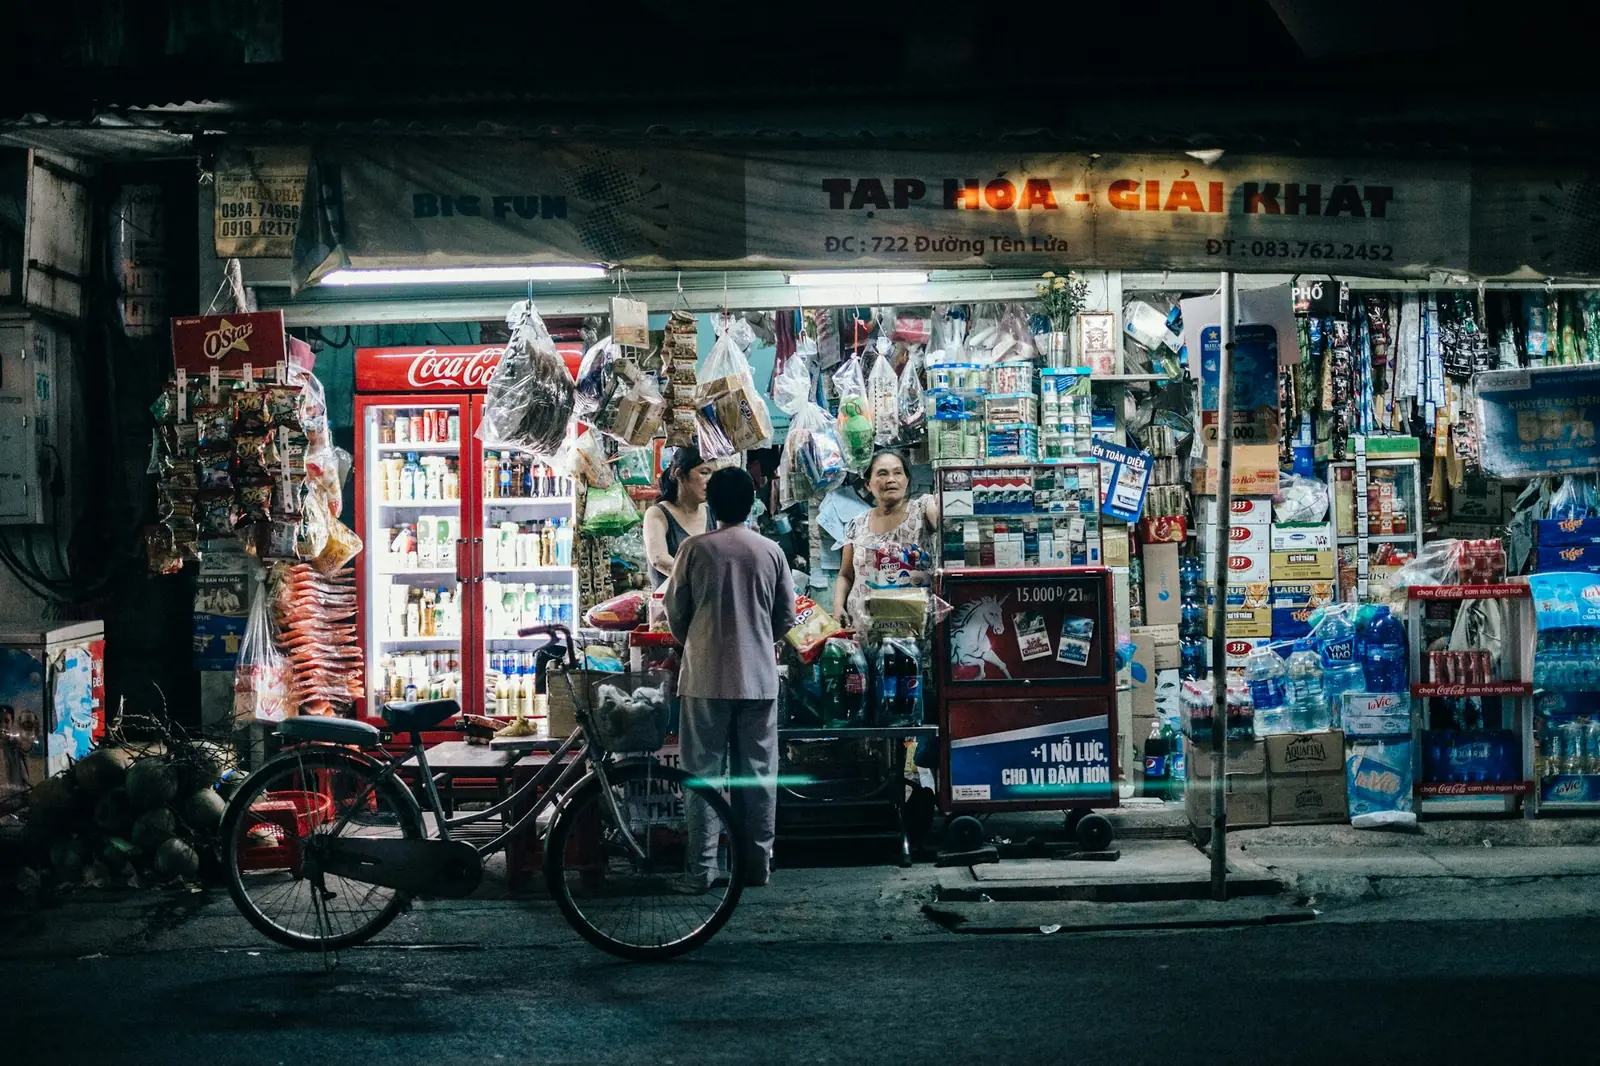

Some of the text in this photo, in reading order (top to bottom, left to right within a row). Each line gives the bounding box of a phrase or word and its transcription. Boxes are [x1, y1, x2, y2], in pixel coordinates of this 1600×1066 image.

[822, 178, 926, 219] TẠP
[943, 171, 1058, 210] HÓA
[1108, 169, 1224, 213] GIẢI
[1243, 178, 1394, 218] KHÁT
[413, 193, 567, 219] BIG FUN
[824, 236, 855, 252] ĐC
[871, 236, 908, 252] 722
[914, 236, 984, 256] Đường
[990, 236, 1026, 252] Tên
[1031, 234, 1068, 252] Lửa
[1206, 239, 1235, 256] ĐT
[1252, 242, 1394, 261] 083.762.2452
[204, 323, 254, 359] O'Star
[408, 348, 504, 387] Coca-Co
[1231, 501, 1246, 509] 333
[1230, 529, 1244, 537] 333
[1557, 519, 1583, 533] Tiger
[1559, 547, 1584, 561] Tiger
[1231, 558, 1245, 567] 333
[1210, 586, 1245, 595] LRUE
[1274, 586, 1310, 594] LARUE
[1435, 587, 1463, 597] Coca-Cola
[1231, 643, 1245, 652] 333
[1329, 643, 1350, 653] VINH
[1419, 687, 1435, 695] chọn
[1437, 685, 1465, 695] Coca-Cola
[1031, 736, 1108, 765] +1 NỖ LỰC,
[1285, 743, 1326, 761] AQUAFINA
[1002, 765, 1110, 787] CHO VỊ ĐẬM HƠN
[1438, 784, 1466, 793] Coca-Cola
